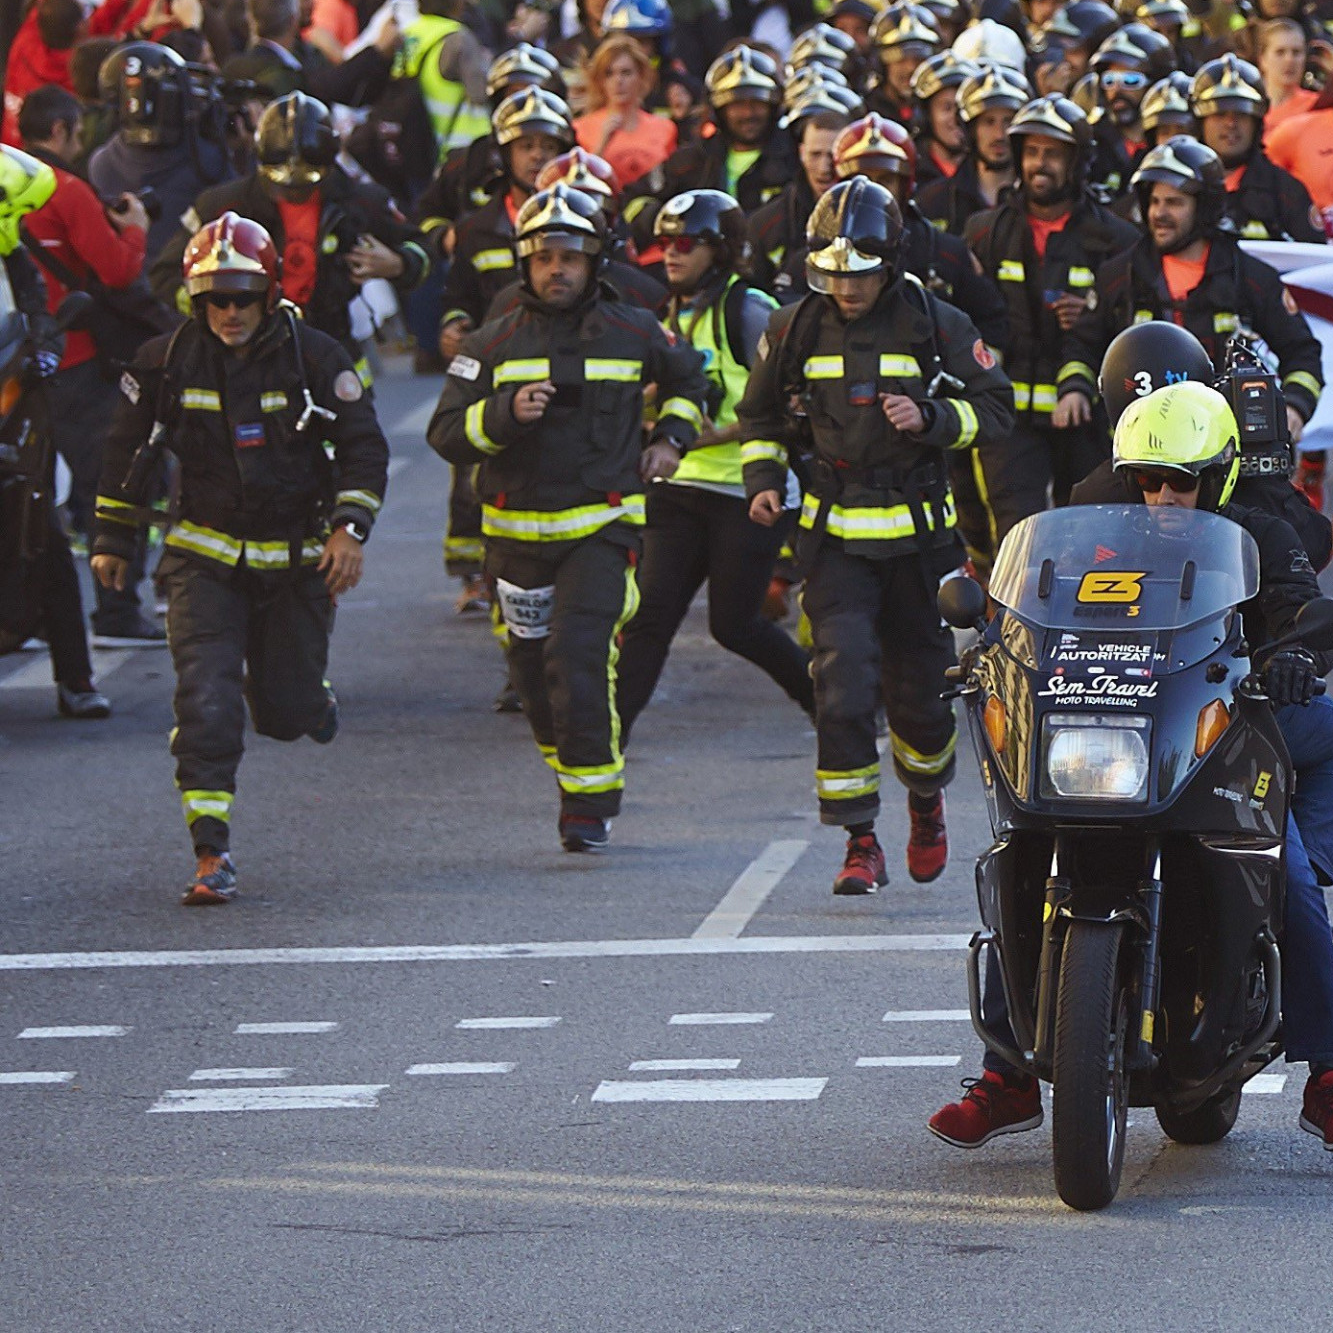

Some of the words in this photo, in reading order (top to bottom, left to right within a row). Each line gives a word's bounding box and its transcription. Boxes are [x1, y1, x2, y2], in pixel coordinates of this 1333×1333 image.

[1133, 371, 1153, 397] 3
[1098, 644, 1152, 653] VEHICLE
[1057, 651, 1151, 662] AUTORITZAT
[1086, 675, 1159, 698] Travel
[1055, 697, 1082, 705] MOTO
[1084, 696, 1139, 708] TRAVELLING
